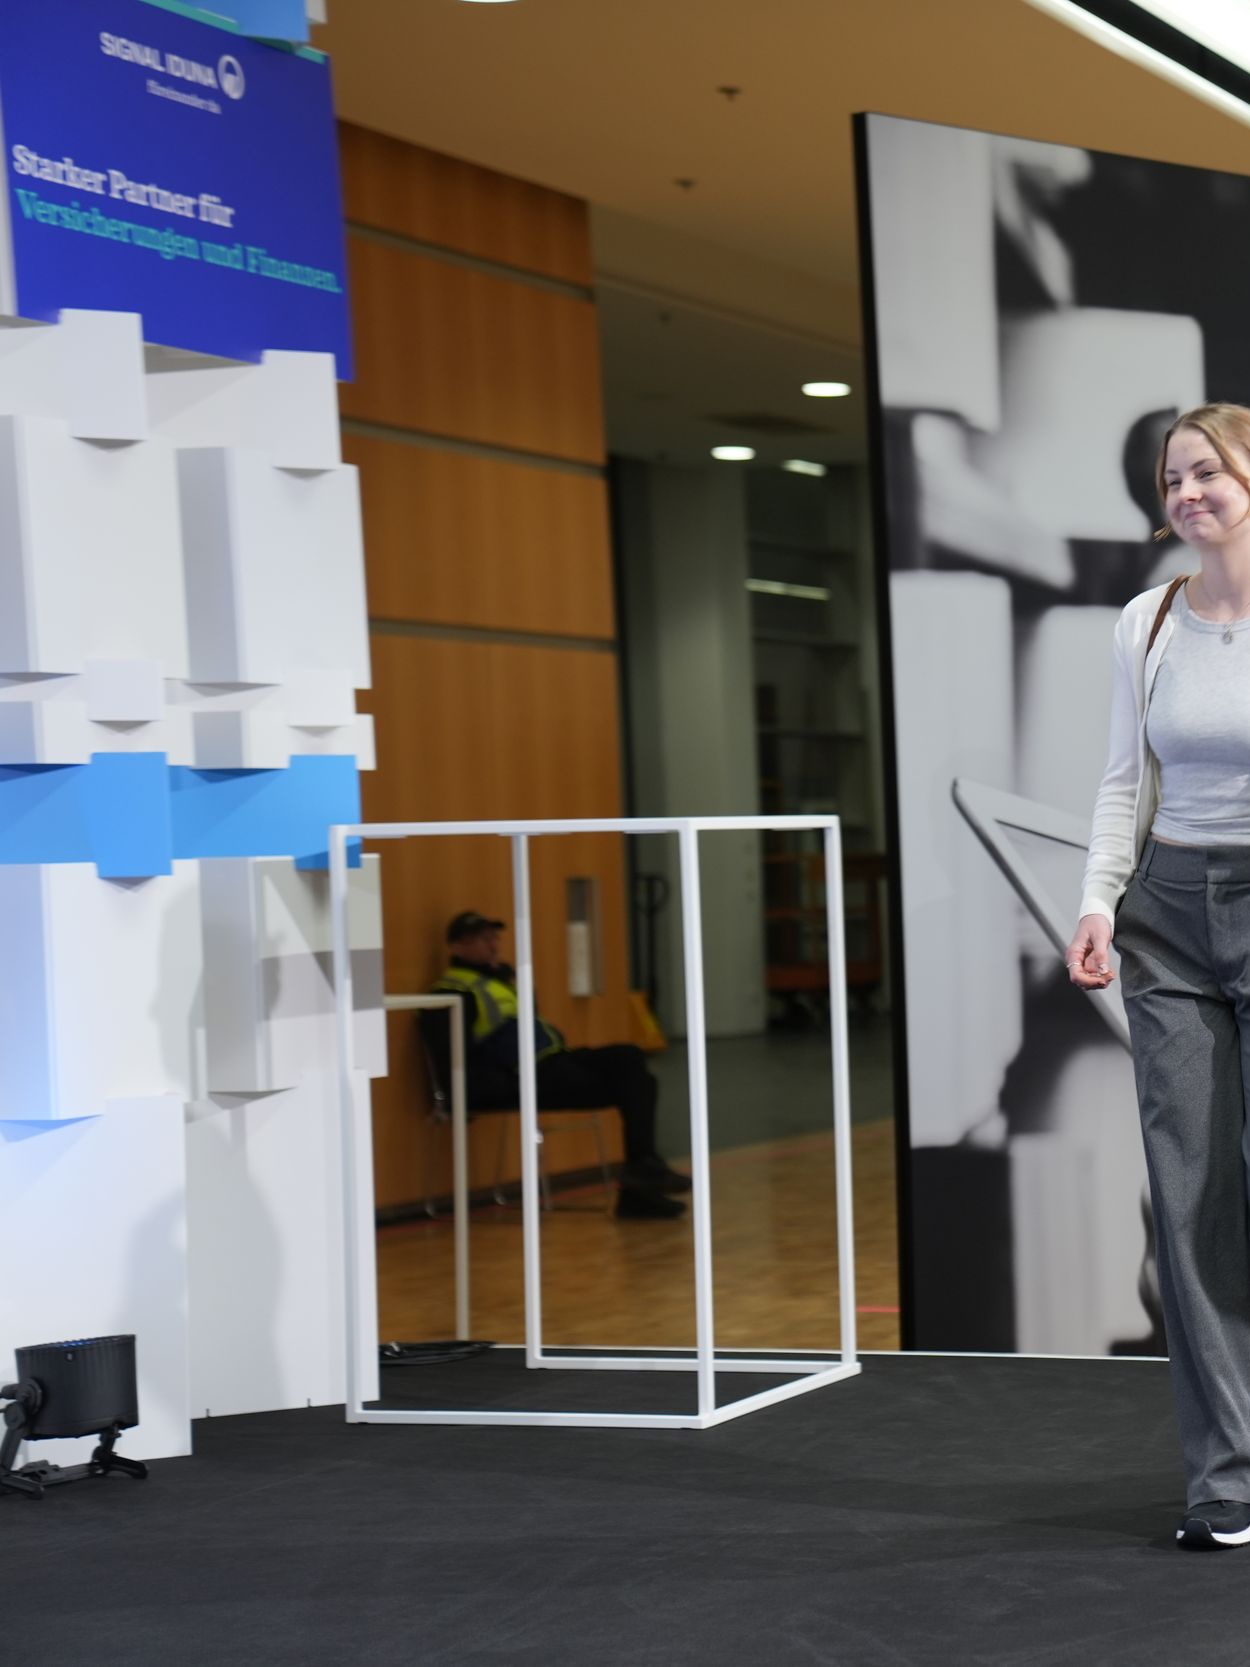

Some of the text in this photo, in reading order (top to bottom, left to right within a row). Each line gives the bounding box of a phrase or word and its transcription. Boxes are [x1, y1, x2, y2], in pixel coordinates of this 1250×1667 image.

[100, 32, 218, 89] SIGNAL IDUNA
[13, 144, 235, 228] Starker Partner für
[14, 188, 201, 260] Versicherungen
[202, 241, 244, 270] und
